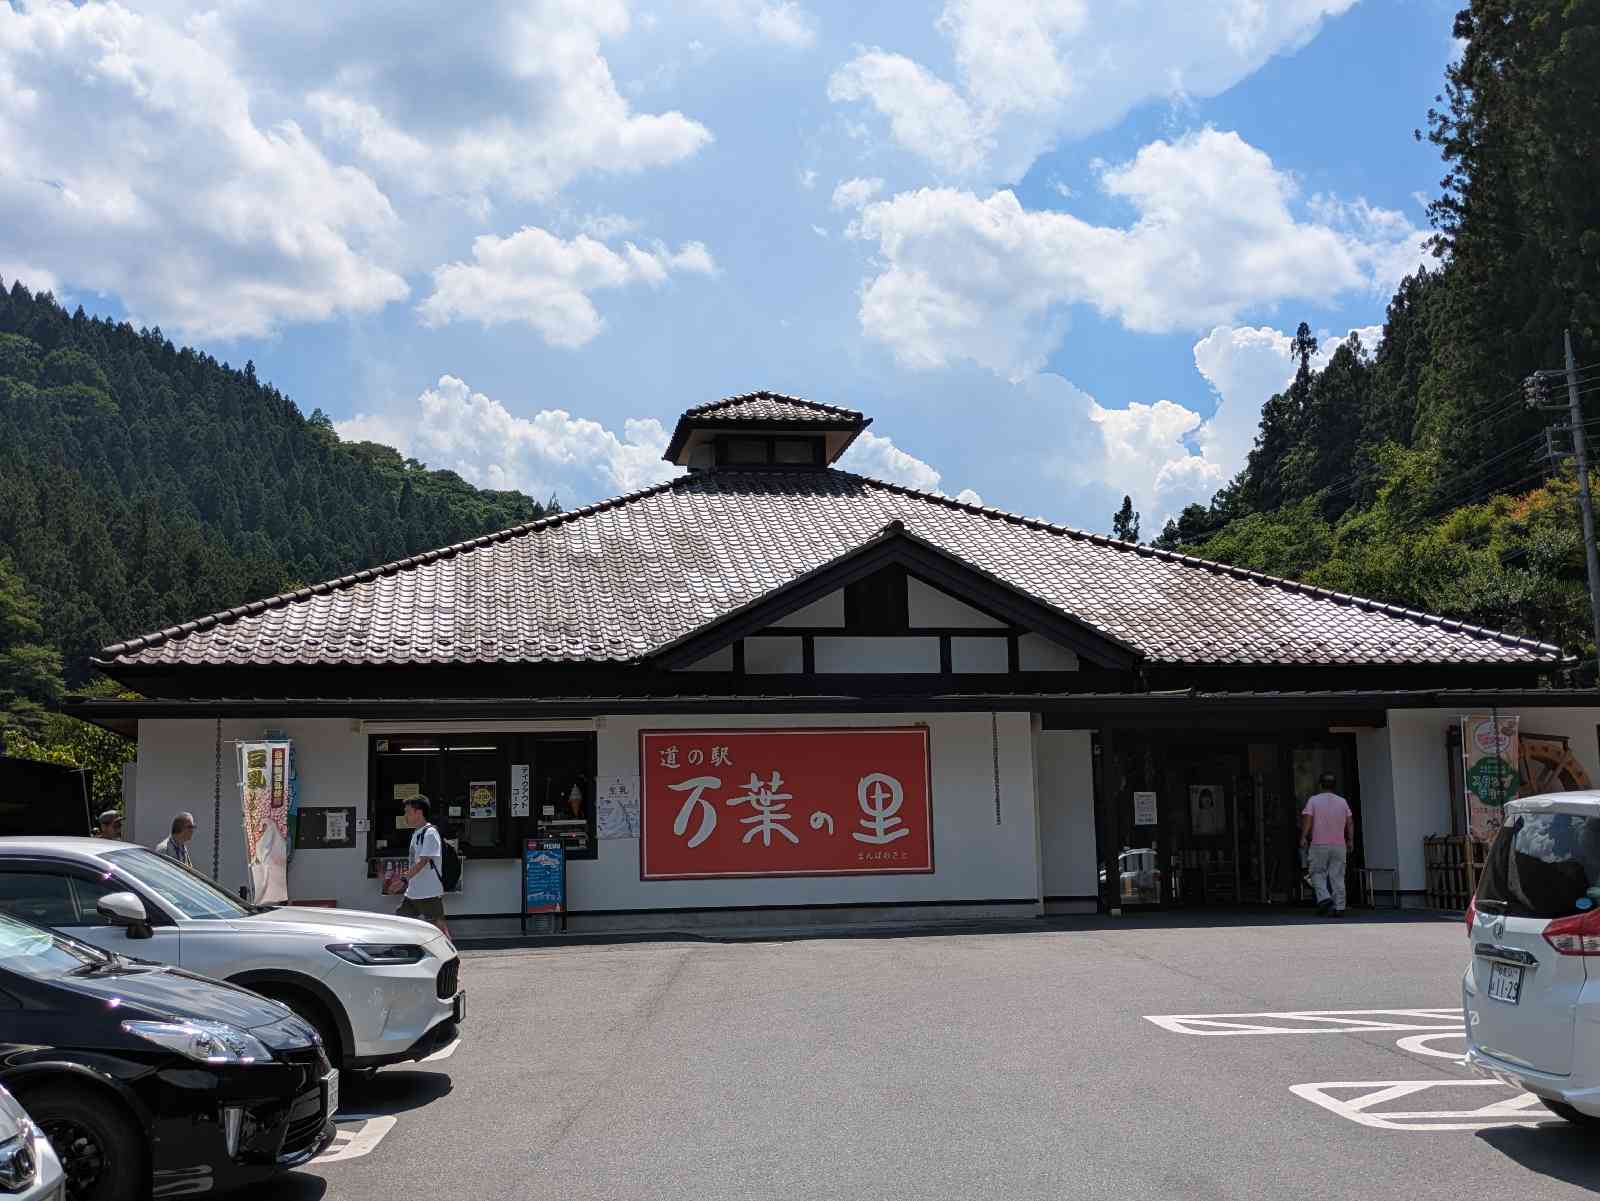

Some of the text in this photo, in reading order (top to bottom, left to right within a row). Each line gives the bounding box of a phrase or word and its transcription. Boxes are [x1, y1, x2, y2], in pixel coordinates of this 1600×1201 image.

[660, 745, 733, 769] 道の駅
[512, 788, 520, 816] コーナー
[520, 767, 529, 809] テイクアウト
[667, 772, 909, 848] 万葉の里
